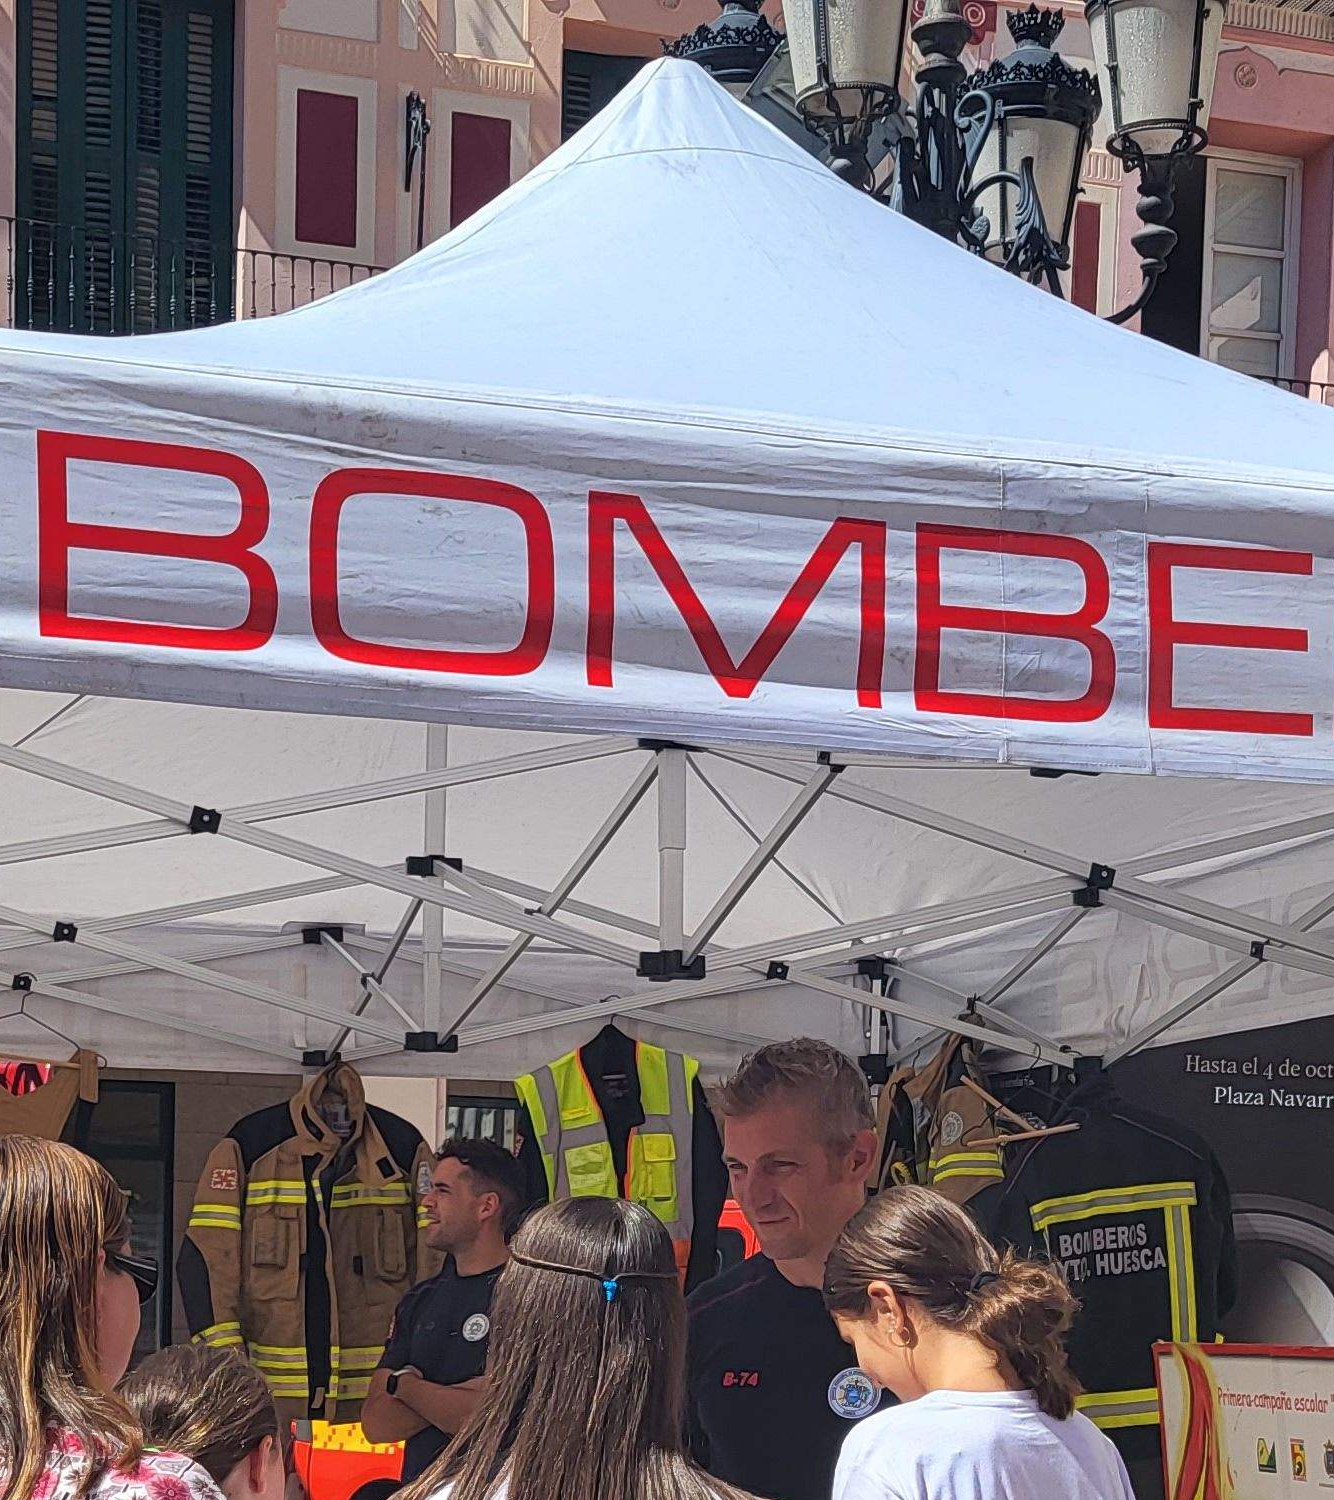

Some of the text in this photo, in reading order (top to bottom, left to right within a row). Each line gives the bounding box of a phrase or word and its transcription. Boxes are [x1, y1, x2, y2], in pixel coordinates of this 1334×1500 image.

[1185, 1054, 1238, 1075] Hasta
[1242, 1057, 1258, 1075] el
[1262, 1063, 1273, 1081] 4
[1278, 1058, 1301, 1077] de
[1213, 1086, 1264, 1106] Plaza
[1058, 1223, 1148, 1258] BOMBEROS
[1095, 1246, 1167, 1276] HUESCA
[722, 1371, 760, 1388] B-74
[1217, 1386, 1252, 1407] Primera
[1254, 1391, 1292, 1415] campaña
[1294, 1392, 1328, 1413] escolar
